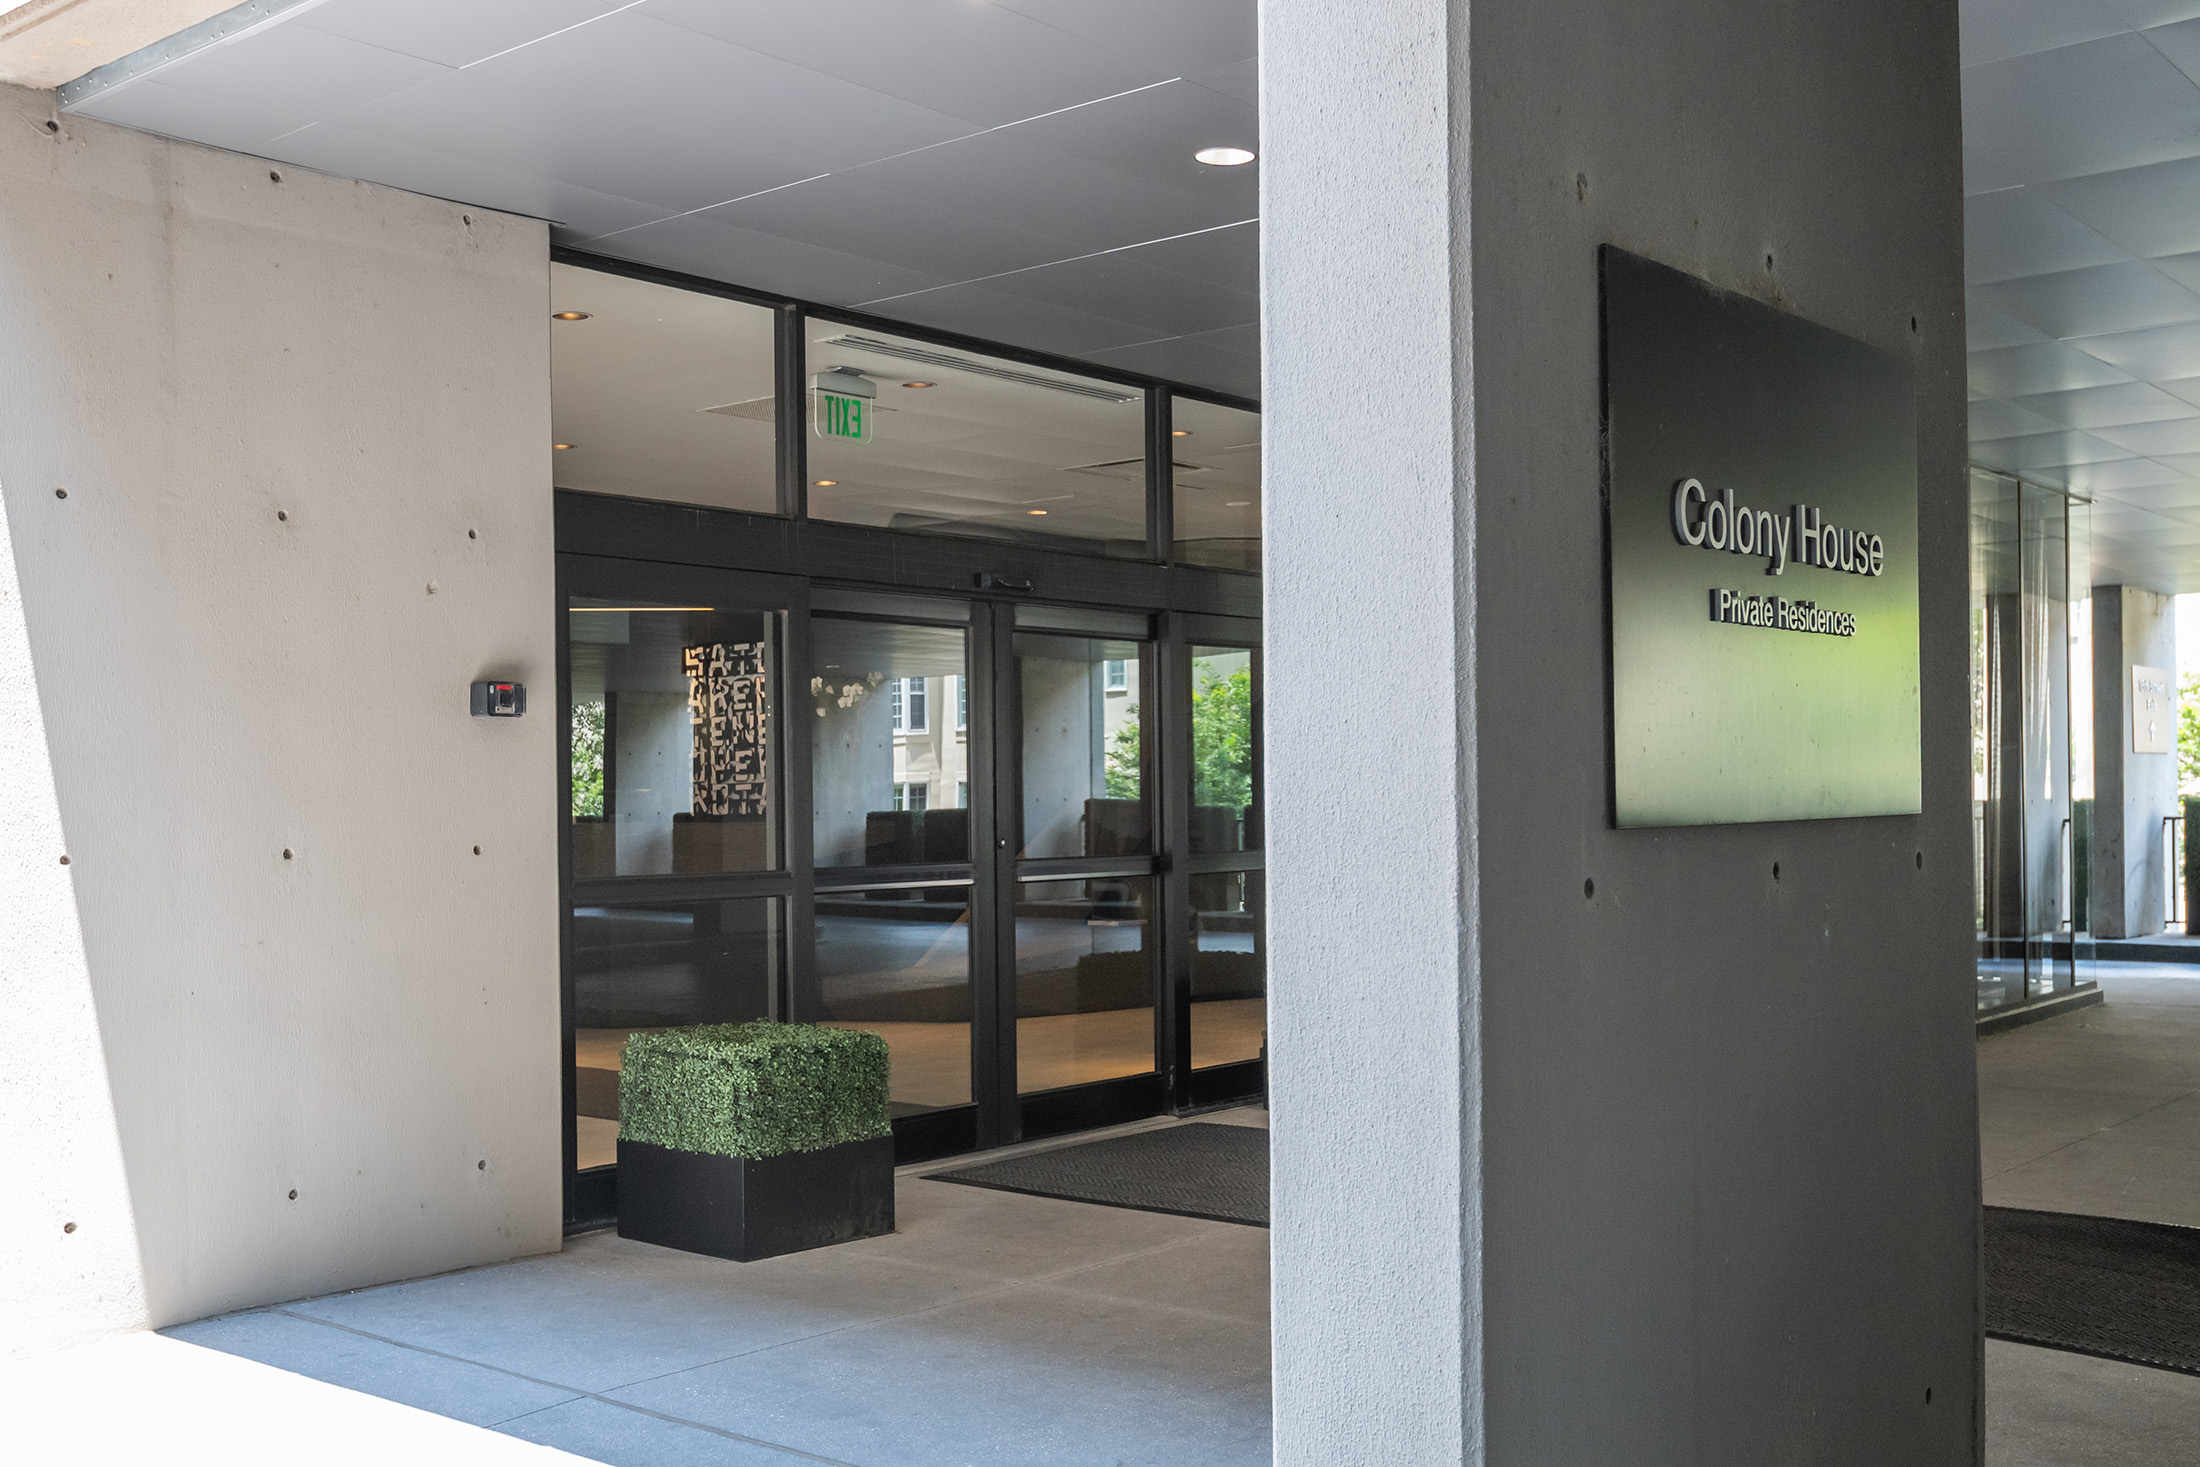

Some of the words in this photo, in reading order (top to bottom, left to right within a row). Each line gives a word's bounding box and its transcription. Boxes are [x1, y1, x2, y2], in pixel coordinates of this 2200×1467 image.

[1676, 478, 1790, 575] Colony
[1798, 504, 1884, 576] House
[1716, 588, 1773, 627] Private
[1777, 596, 1857, 636] Residences
